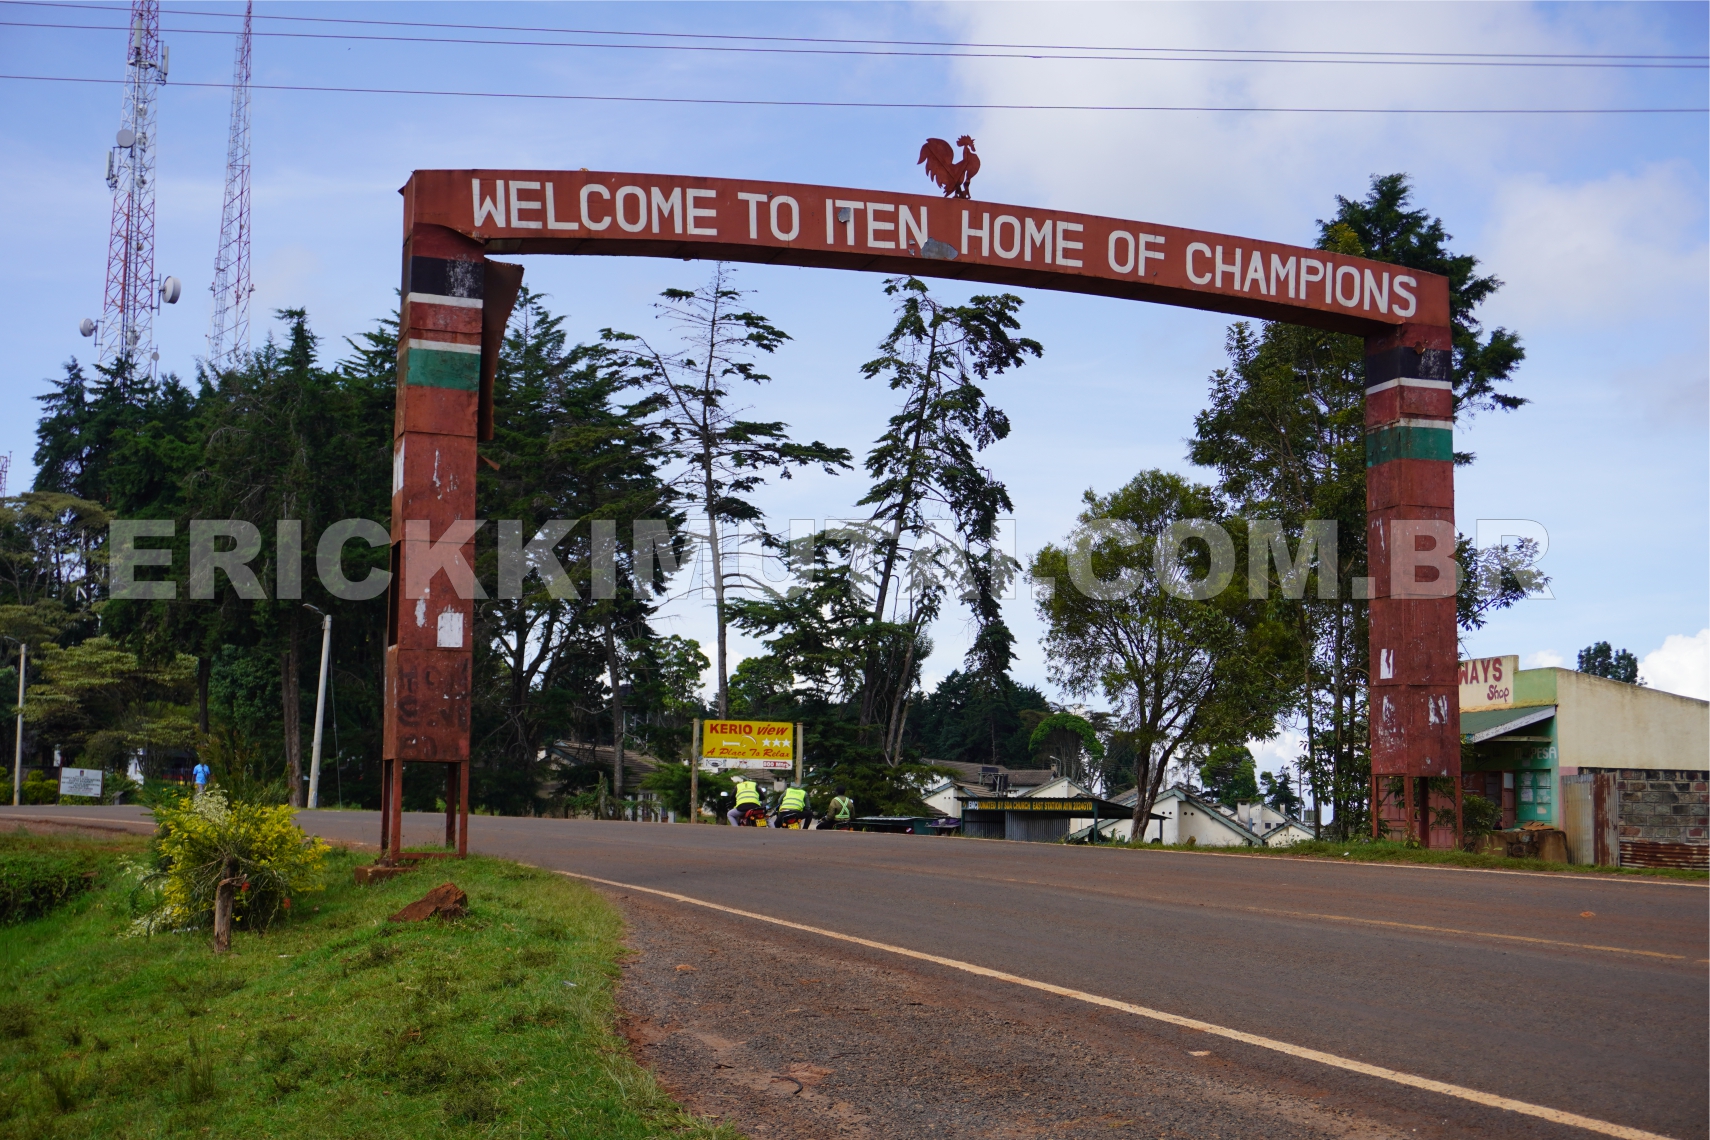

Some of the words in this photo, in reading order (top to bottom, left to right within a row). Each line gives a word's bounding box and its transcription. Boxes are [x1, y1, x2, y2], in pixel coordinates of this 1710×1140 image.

[471, 178, 718, 236] WELCOME
[737, 192, 799, 241] TO
[825, 199, 928, 250] ITEN
[961, 210, 1084, 268] HOME
[1107, 230, 1165, 277] OF
[1185, 242, 1418, 318] CHAMPIONS
[1487, 684, 1510, 703] Shop
[709, 724, 753, 735] KERIO
[757, 724, 789, 736] view
[706, 747, 716, 758] A
[719, 748, 747, 757] Place
[749, 748, 760, 758] To
[763, 749, 790, 758] Relax
